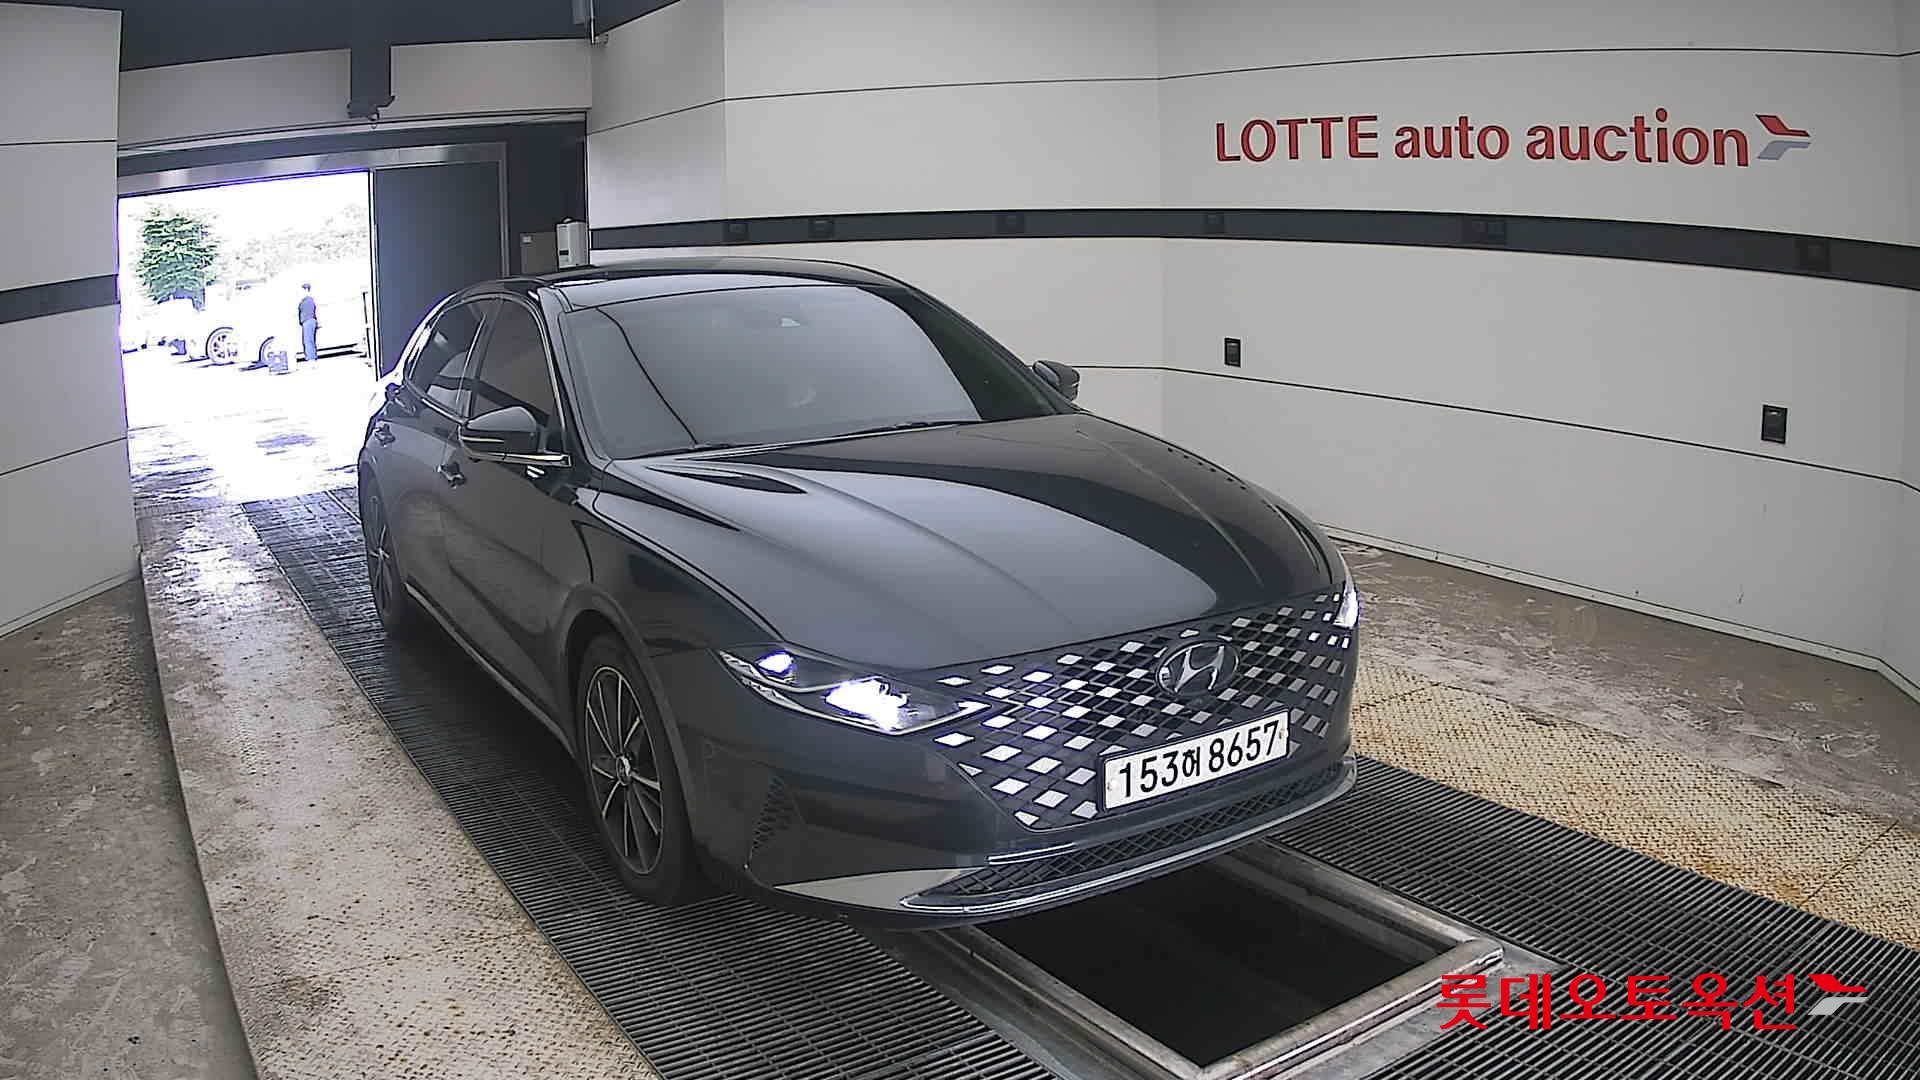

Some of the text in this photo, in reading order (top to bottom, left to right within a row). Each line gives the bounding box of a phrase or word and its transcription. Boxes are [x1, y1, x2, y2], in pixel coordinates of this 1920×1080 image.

[1215, 108, 1749, 167] LOTTE auto auction
[1119, 720, 1280, 798] 153허 8657
